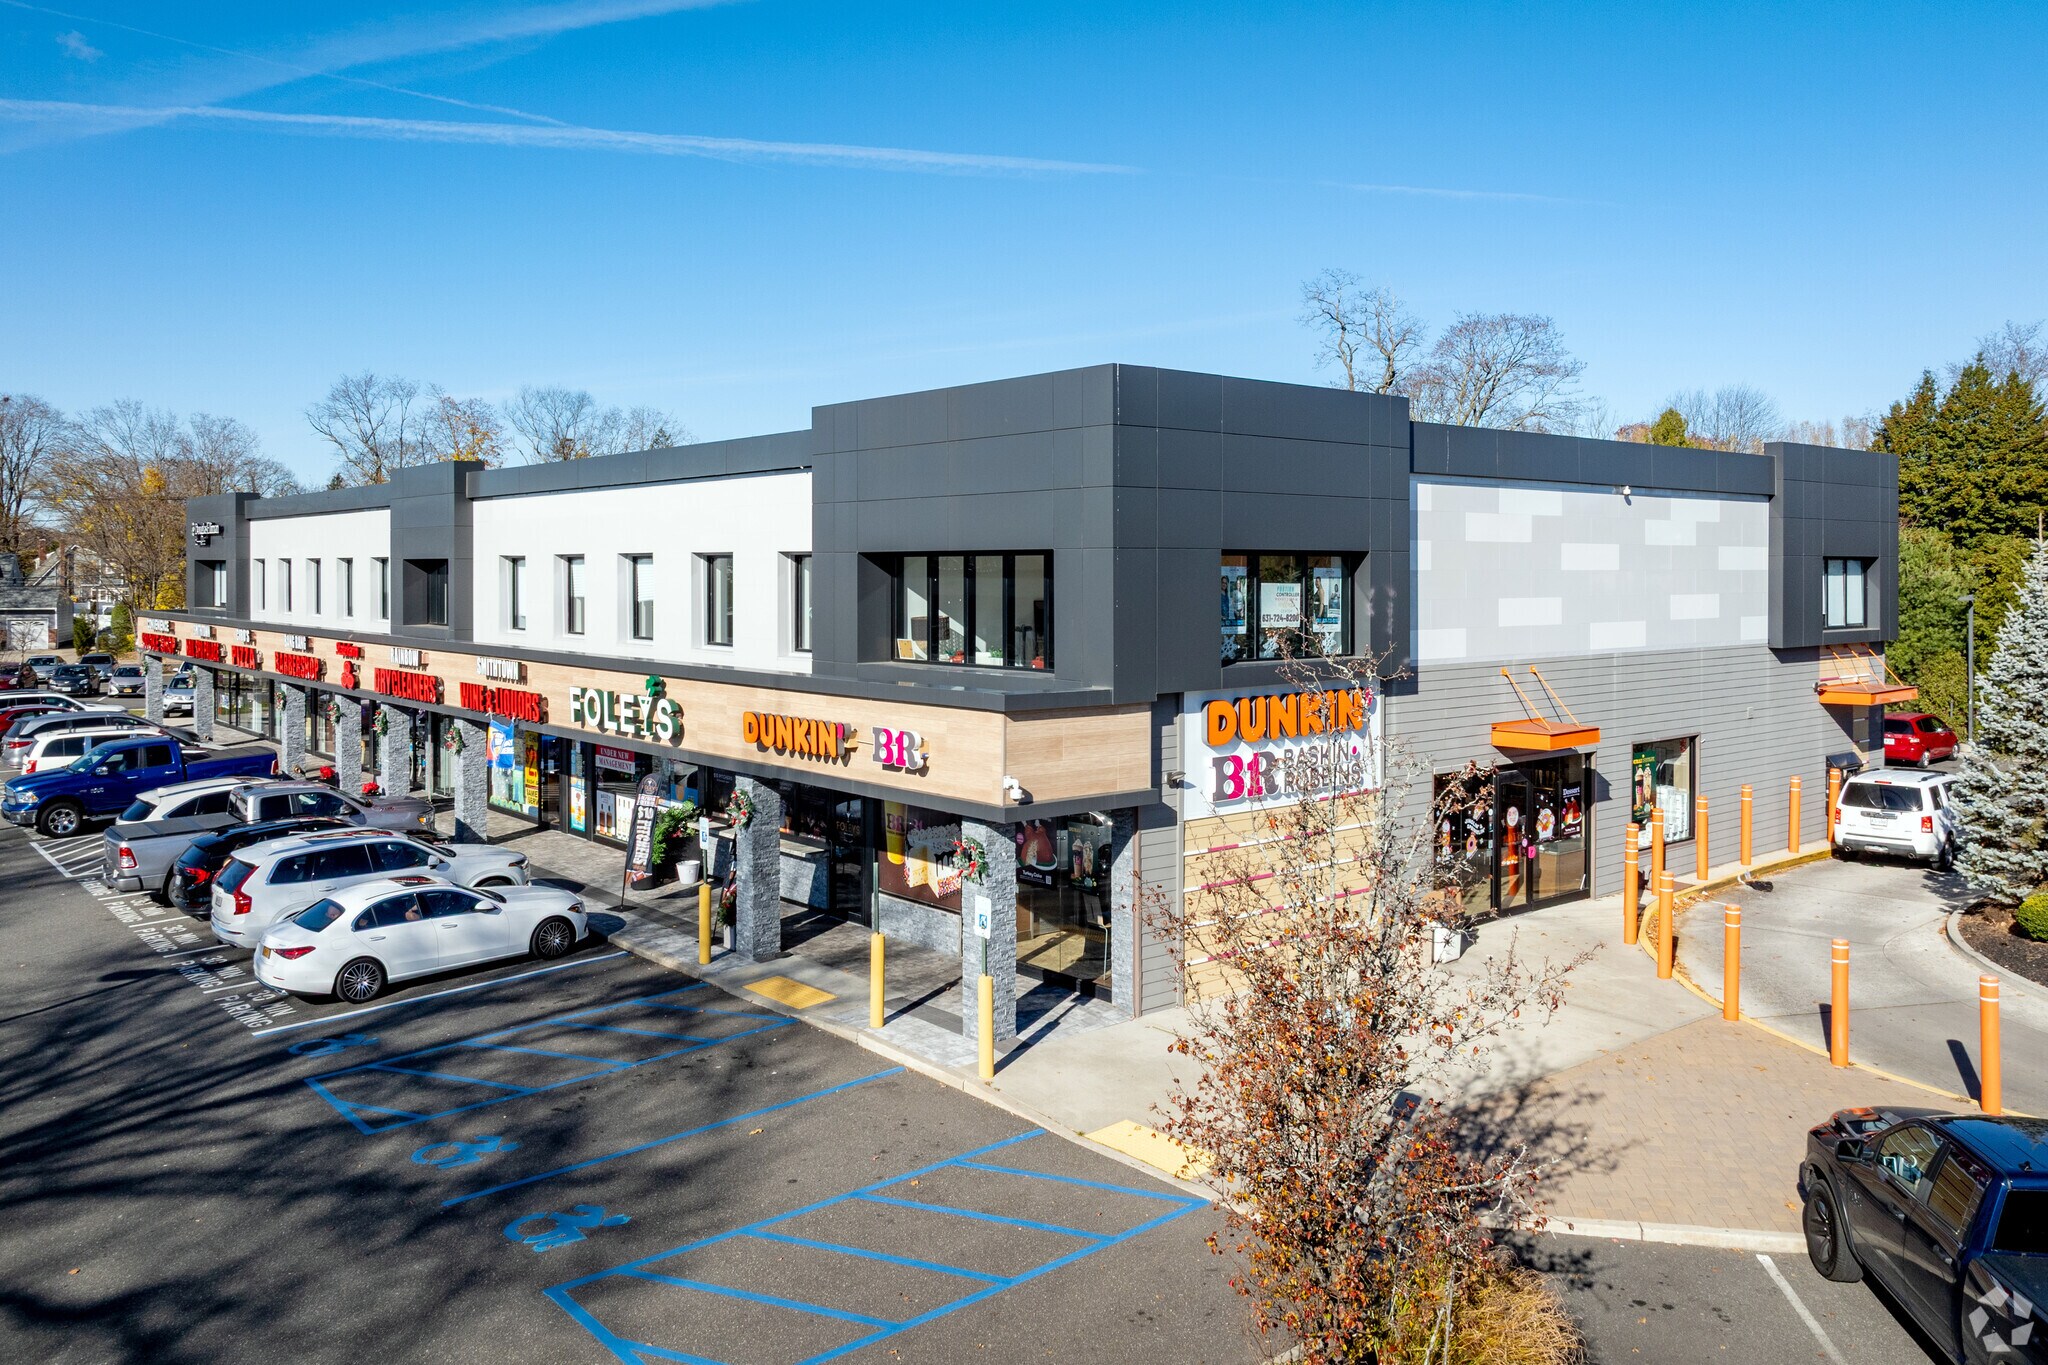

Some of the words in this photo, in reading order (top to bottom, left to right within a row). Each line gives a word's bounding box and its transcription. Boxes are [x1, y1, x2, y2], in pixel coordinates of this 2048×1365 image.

[1262, 613, 1300, 622] 631-724-8200
[231, 645, 256, 670] PIZZA
[274, 651, 319, 680] BARBERSHOP
[390, 647, 419, 667] RAINBOW
[476, 656, 519, 681] SMITHTOWN
[374, 667, 391, 695] DRY
[391, 669, 437, 704] CLEANERS
[459, 682, 485, 712] WINE
[486, 691, 493, 713] &
[495, 687, 540, 723] LIQUORS
[743, 711, 844, 758] DUNKIN'
[599, 757, 633, 772] MANAGEMENT
[600, 747, 618, 758] UNDER
[618, 751, 629, 760] NEW
[103, 901, 143, 923] PARKING
[133, 927, 178, 952] PARKING
[201, 955, 228, 965] 30
[214, 965, 246, 980] MIN
[171, 960, 224, 988] PARKING
[214, 994, 274, 1028] PARKING
[246, 989, 276, 1002] 30
[261, 1001, 297, 1017] MIN
